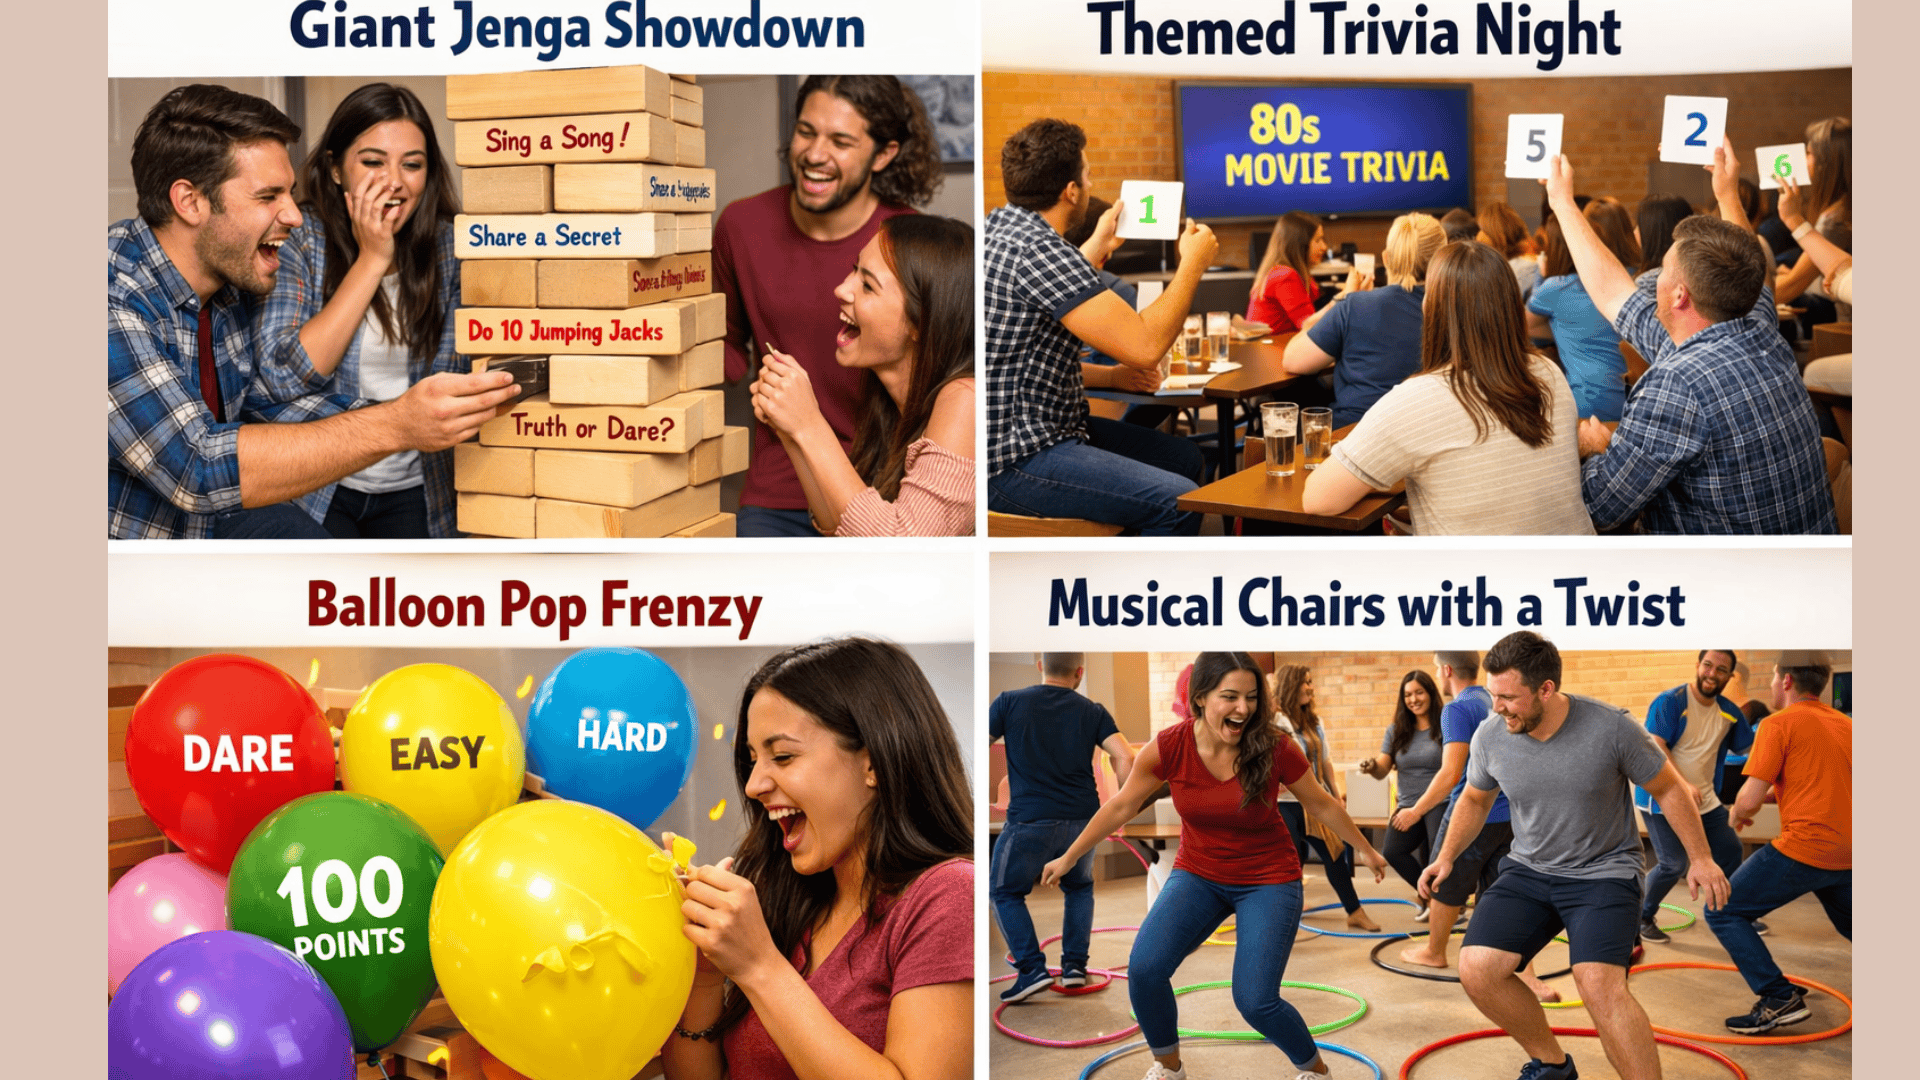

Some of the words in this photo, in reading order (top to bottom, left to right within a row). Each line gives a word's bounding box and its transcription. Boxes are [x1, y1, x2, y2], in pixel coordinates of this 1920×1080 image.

[1249, 102, 1321, 145] 80s
[1684, 111, 1709, 147] 2
[486, 127, 532, 158] Sing
[540, 134, 553, 150] a
[1525, 129, 1547, 163] 5
[1225, 151, 1332, 187] MOVIE
[1340, 150, 1450, 183] TRIVIA
[1772, 153, 1793, 178] 6
[1139, 194, 1158, 224] 1
[469, 223, 527, 247] Share
[534, 231, 547, 247] a
[555, 223, 622, 246] Secret
[468, 318, 494, 342] Do
[501, 318, 524, 342] 10
[529, 319, 603, 347] Jumping
[609, 318, 664, 342] Jacks
[510, 412, 567, 438] Truth
[575, 422, 597, 438] or
[607, 414, 676, 442] Dare?
[577, 719, 668, 752] HARD
[183, 733, 295, 773] DARE
[390, 735, 486, 772] EASY
[276, 855, 404, 927] 100
[293, 927, 406, 961] POINTS
